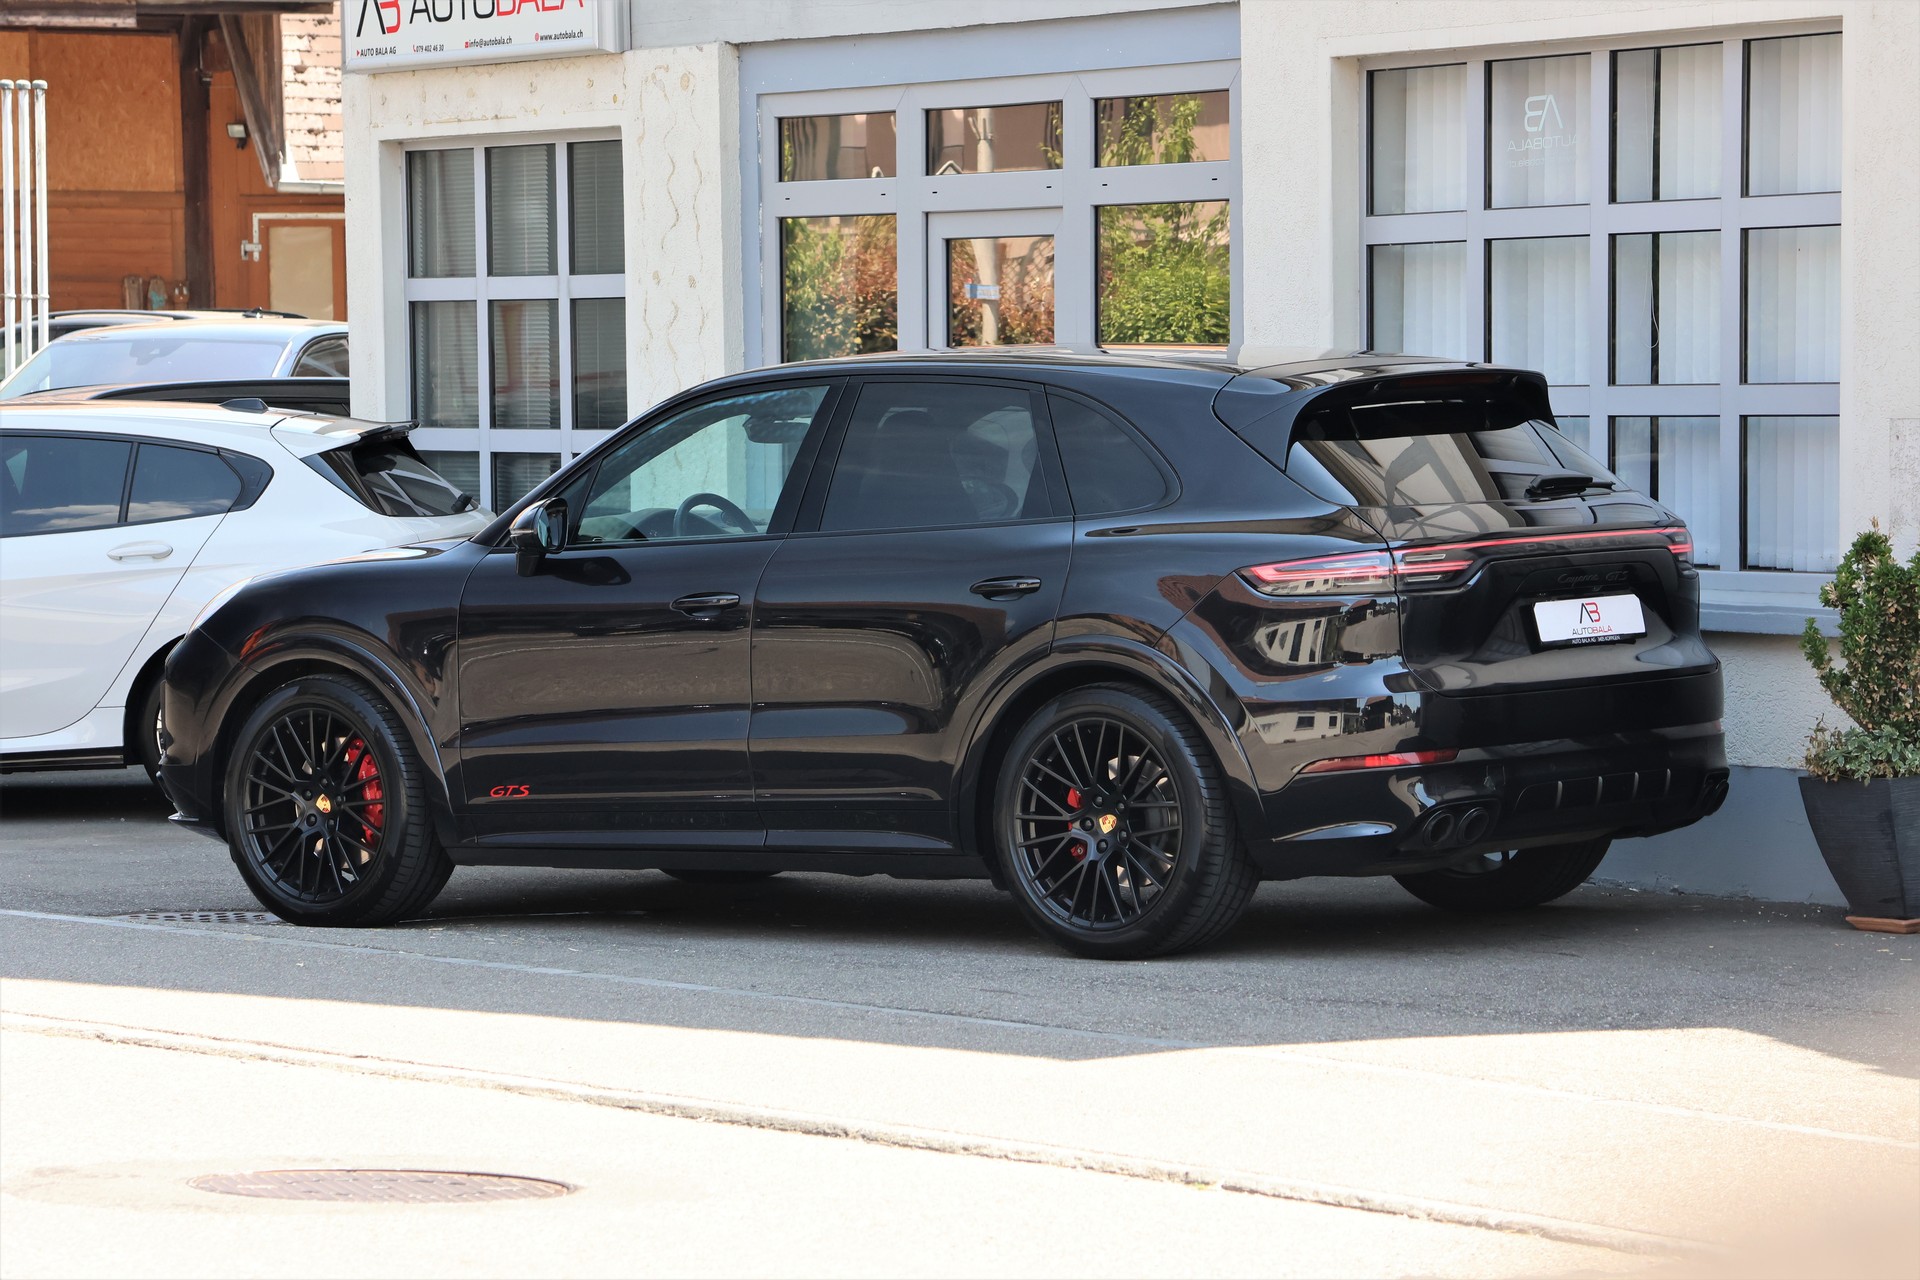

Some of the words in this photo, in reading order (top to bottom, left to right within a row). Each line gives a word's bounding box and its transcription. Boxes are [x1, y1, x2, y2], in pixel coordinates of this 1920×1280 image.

[409, 0, 584, 24] AUTO
[539, 29, 584, 41] www.autobala.ch
[468, 36, 513, 48] info@autobala.ch
[360, 48, 375, 57] AUTO
[375, 47, 389, 56] BALA
[389, 46, 397, 55] AG
[416, 45, 424, 53] 079
[432, 44, 438, 52] 46
[438, 44, 444, 52] 30
[1605, 570, 1630, 582] GTS
[1572, 625, 1613, 636] AUTOBALA
[490, 785, 530, 798] GTS
